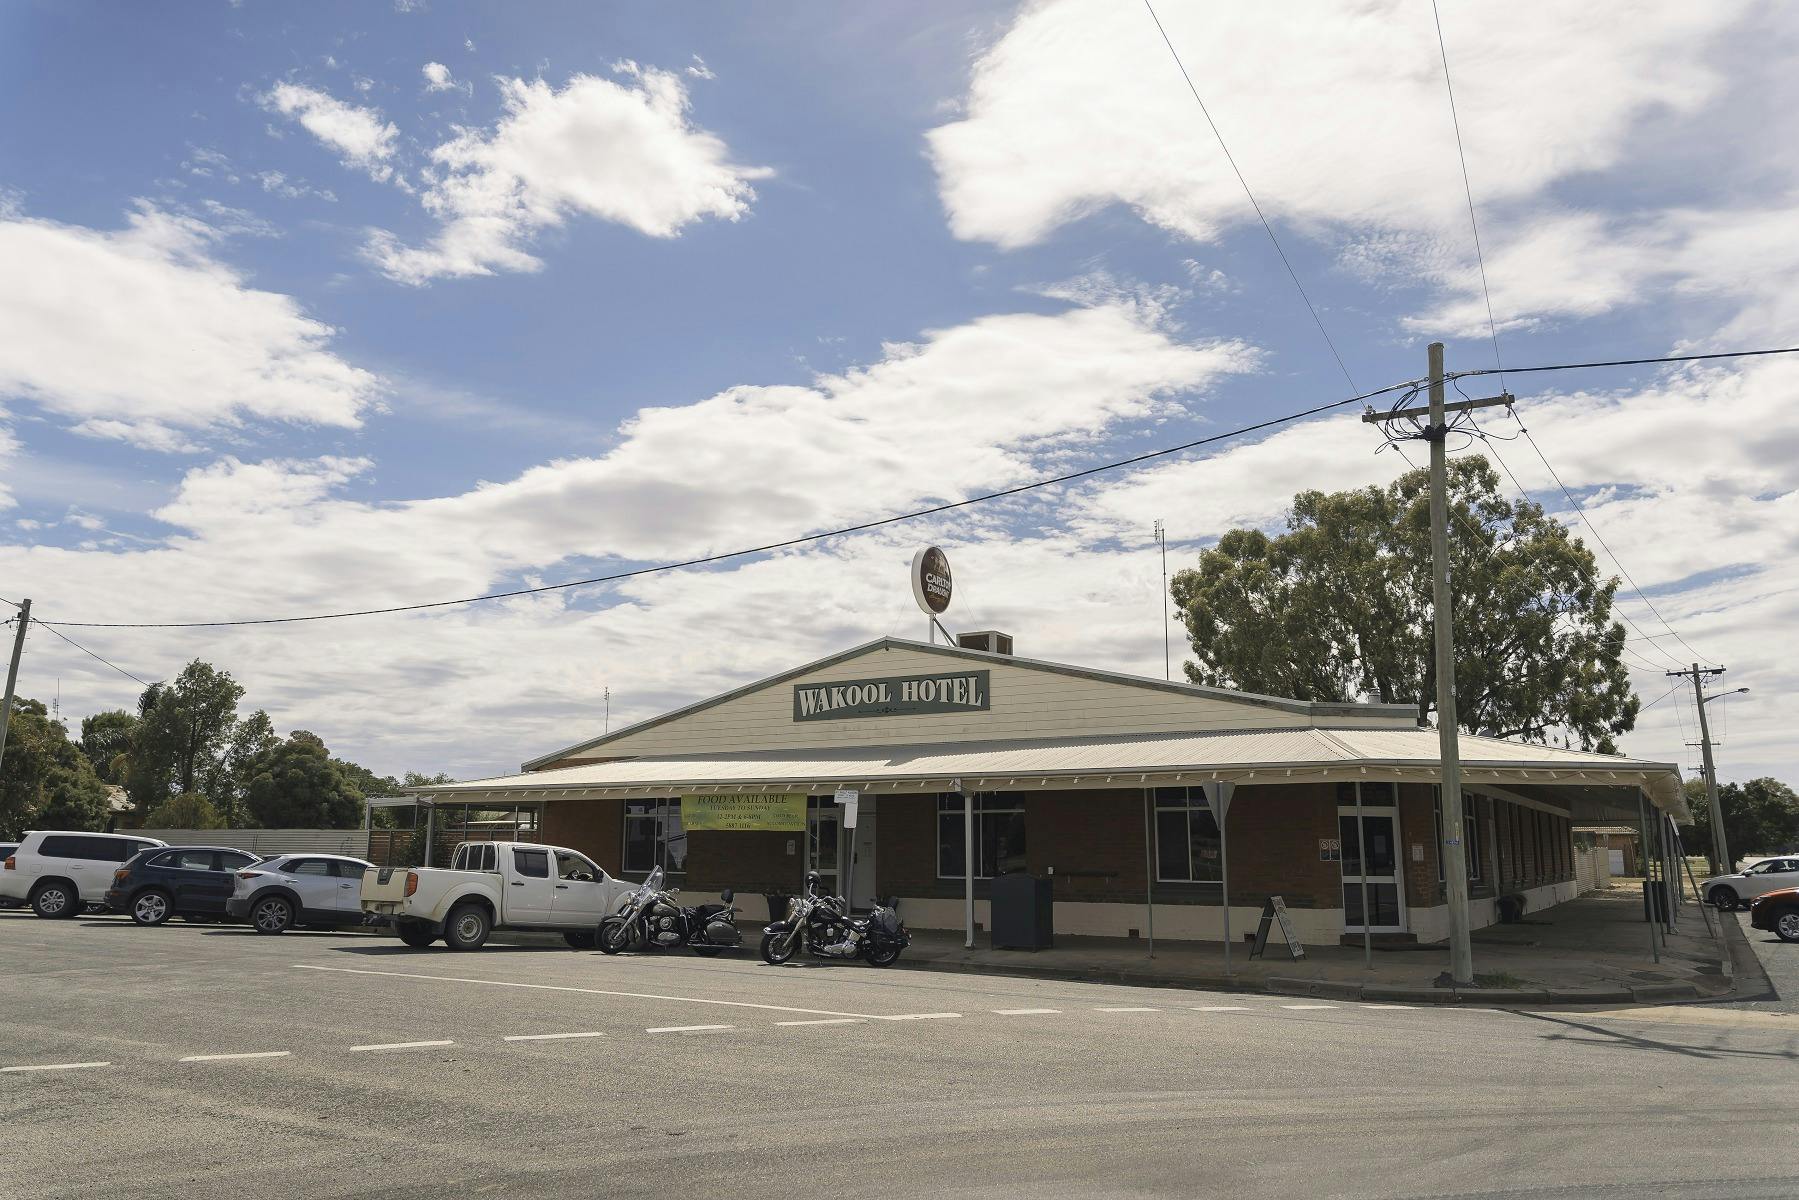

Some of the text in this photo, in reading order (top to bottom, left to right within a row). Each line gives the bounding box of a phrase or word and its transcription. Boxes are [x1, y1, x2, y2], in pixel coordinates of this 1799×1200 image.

[798, 676, 983, 717] WAKOOL HOTEL
[697, 793, 789, 805] FOOD AVAILABLE
